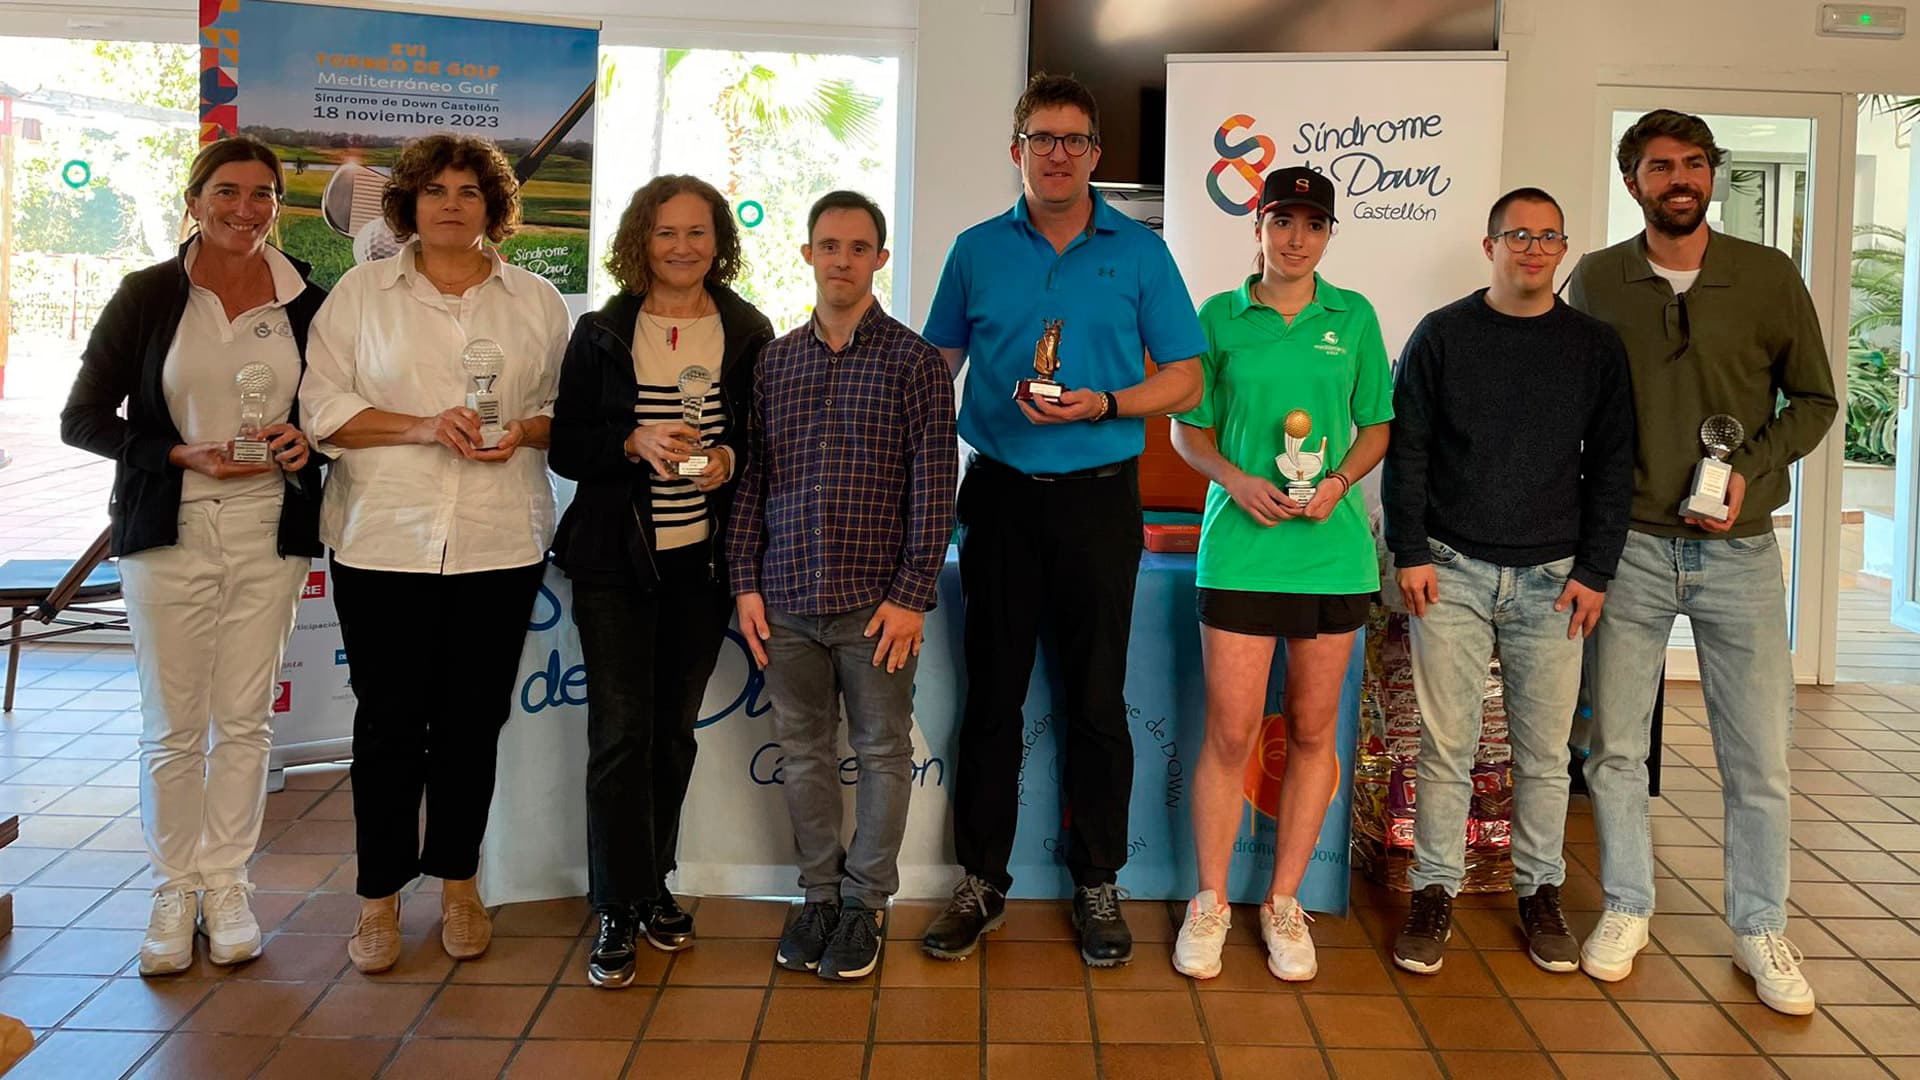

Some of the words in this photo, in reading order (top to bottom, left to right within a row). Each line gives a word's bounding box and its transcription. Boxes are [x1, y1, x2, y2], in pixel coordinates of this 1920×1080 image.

[316, 52, 408, 73] TORNEO
[413, 60, 441, 76] DE
[447, 62, 500, 80] GOLF
[317, 72, 453, 93] Mediterráneo
[458, 81, 499, 95] Golf
[313, 105, 339, 120] 18
[346, 109, 444, 125] noviembre
[450, 113, 499, 128] 2023
[315, 92, 378, 106] Síndrome
[382, 95, 398, 107] de
[402, 97, 437, 109] Down
[441, 100, 500, 113] Castellón
[1293, 115, 1443, 154] Síndrome
[1330, 152, 1451, 198] Down
[1353, 201, 1437, 221] Castellón
[521, 649, 588, 713] de
[1145, 717, 1166, 741] de
[1161, 741, 1183, 808] DOWN
